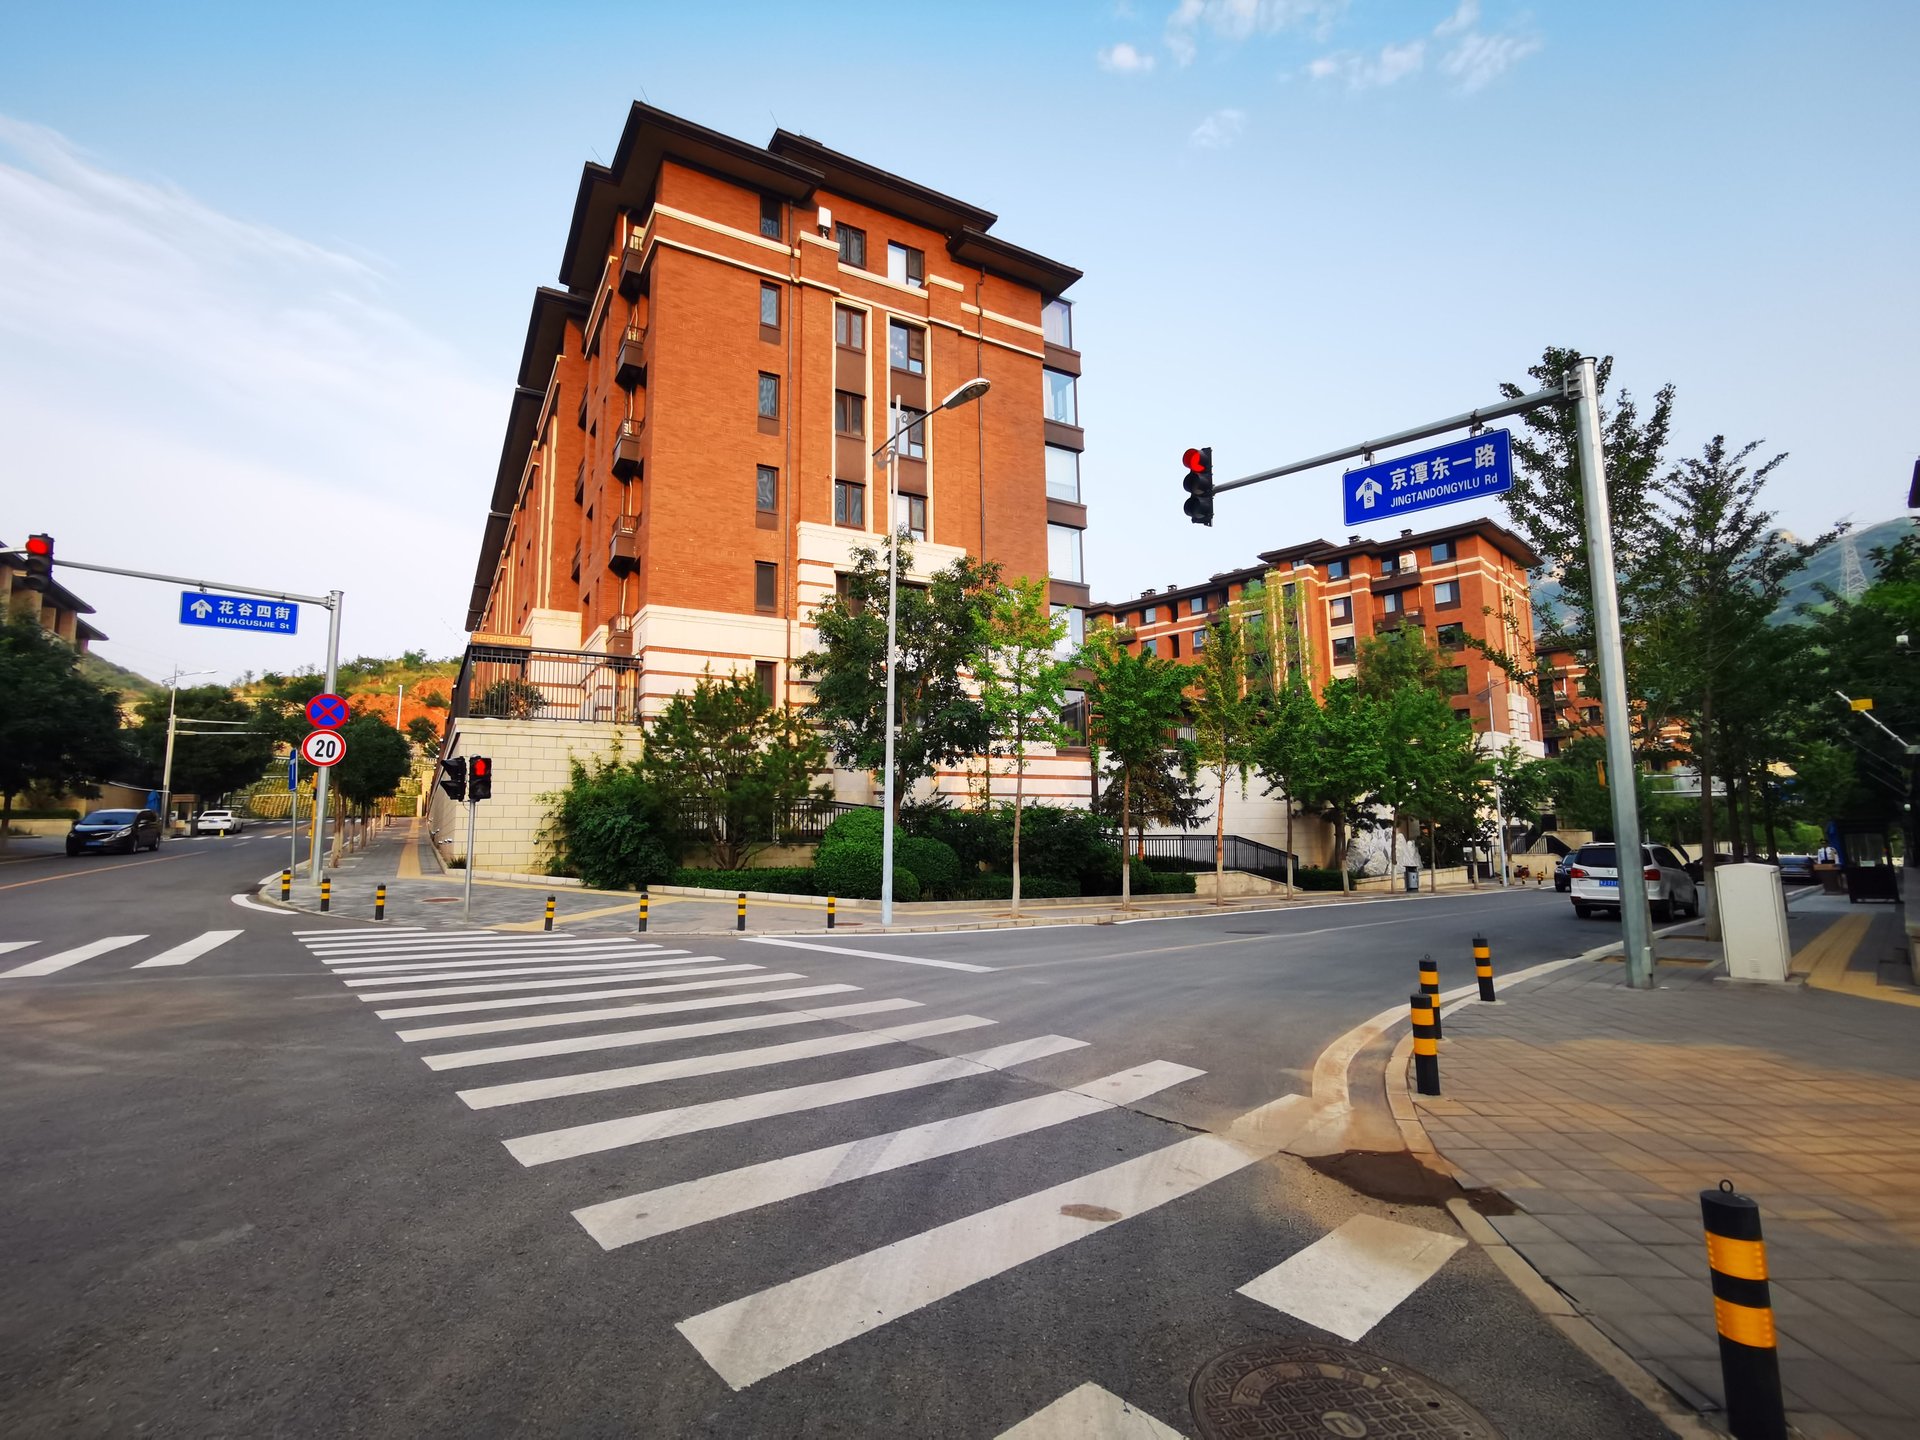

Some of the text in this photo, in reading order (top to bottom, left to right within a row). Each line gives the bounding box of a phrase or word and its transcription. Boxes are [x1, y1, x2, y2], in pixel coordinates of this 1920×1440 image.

[1389, 443, 1497, 491] 京潭东一路
[1364, 481, 1373, 492] 南
[1390, 471, 1499, 508] JINGTANDONGYILU Rd
[1366, 495, 1372, 504] S
[218, 600, 291, 621] 花谷四街
[216, 616, 290, 630] HUAGUSIJIE St
[314, 739, 337, 758] 20
[1323, 1416, 1362, 1435] TV
